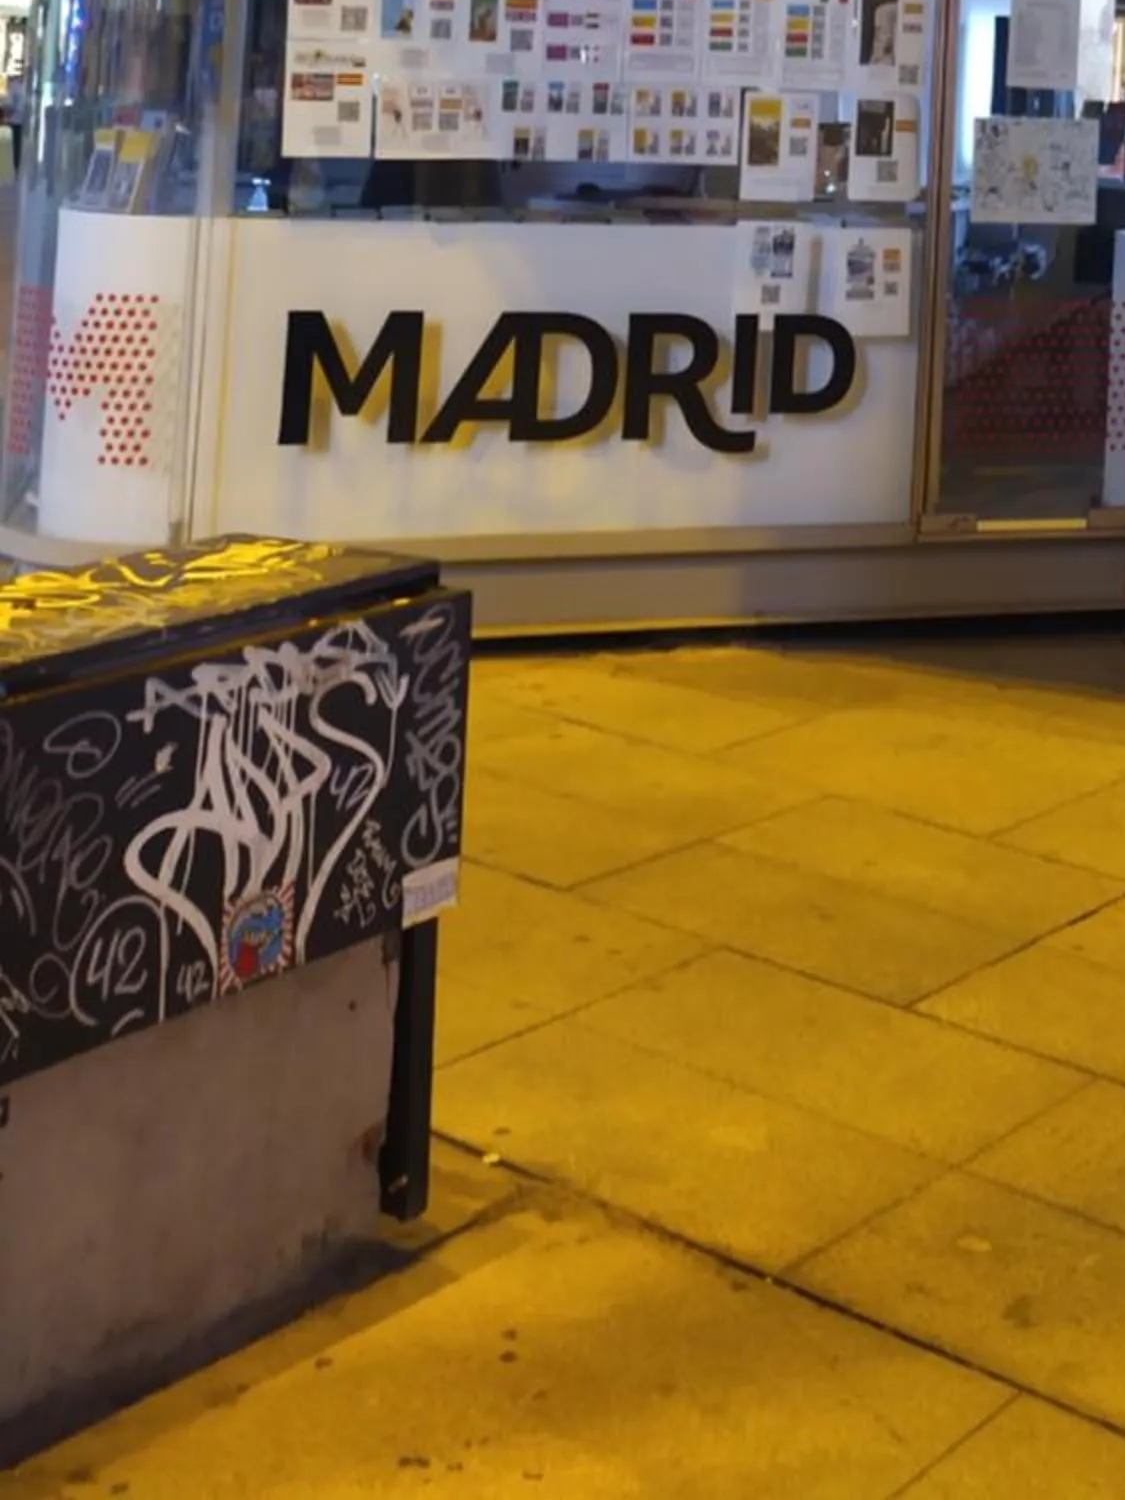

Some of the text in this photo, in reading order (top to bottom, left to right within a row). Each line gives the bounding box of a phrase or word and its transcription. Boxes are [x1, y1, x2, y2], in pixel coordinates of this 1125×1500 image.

[278, 309, 857, 453] MADRID
[86, 924, 148, 1001] 42
[176, 959, 210, 1004] 42
